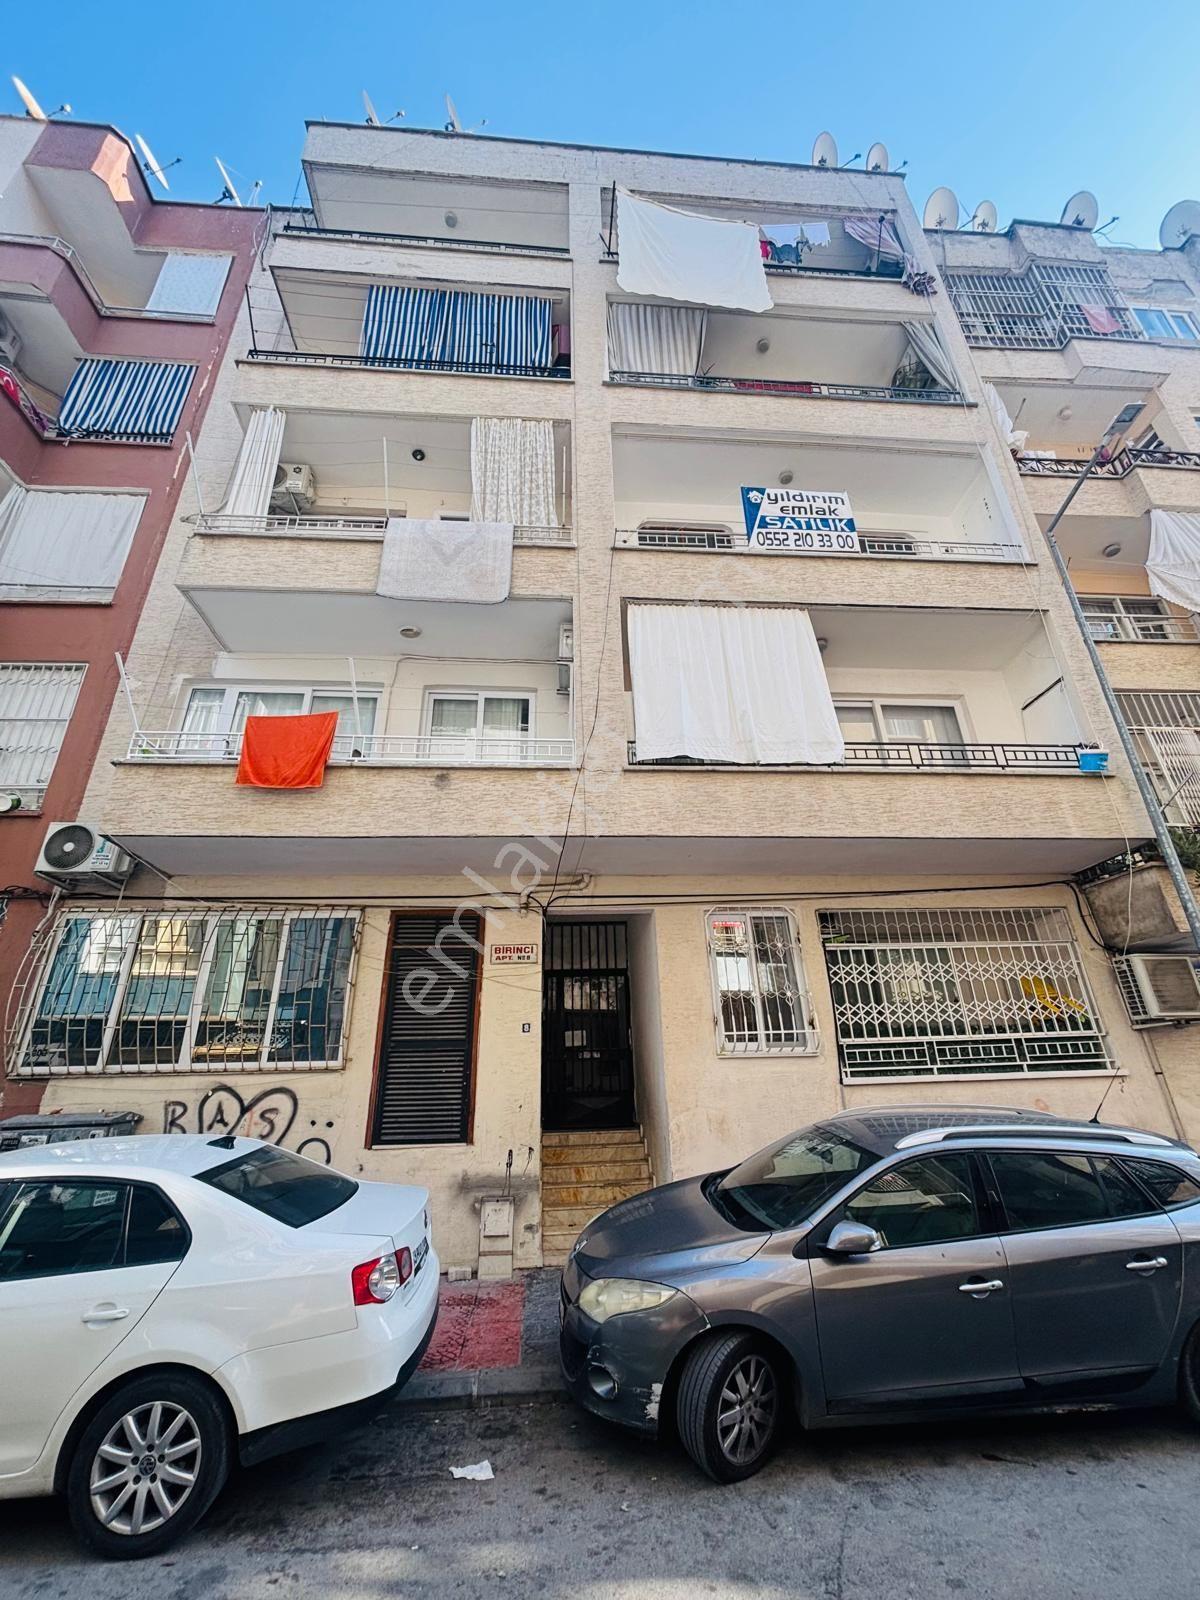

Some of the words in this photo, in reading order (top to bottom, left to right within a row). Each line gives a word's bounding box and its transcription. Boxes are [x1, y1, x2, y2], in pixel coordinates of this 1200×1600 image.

[779, 503, 839, 516] emlak
[765, 516, 850, 532] SATILIK
[756, 531, 790, 546] 0552
[794, 532, 813, 548] 210
[817, 533, 833, 547] 33
[836, 534, 855, 549] 00
